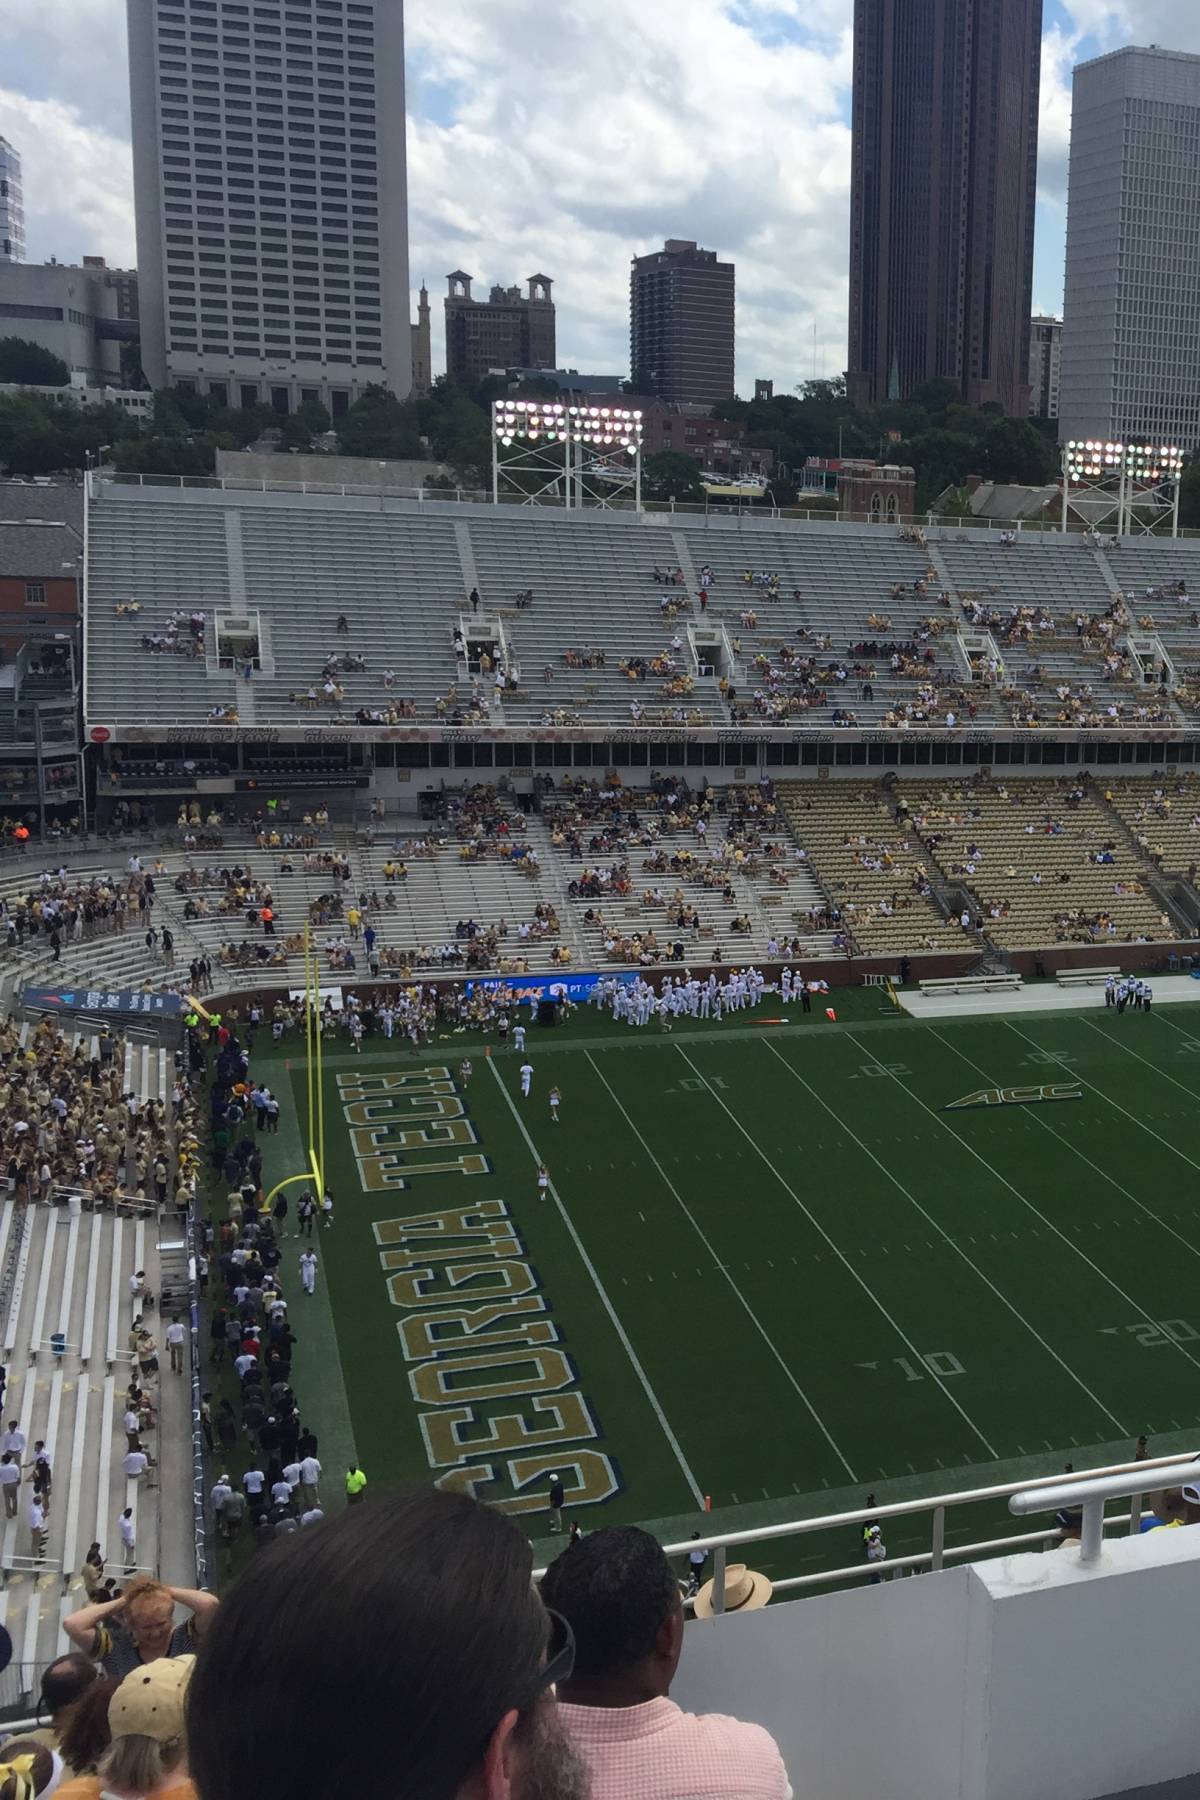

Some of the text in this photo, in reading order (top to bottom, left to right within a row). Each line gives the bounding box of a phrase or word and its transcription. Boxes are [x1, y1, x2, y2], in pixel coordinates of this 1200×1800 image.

[167, 733, 280, 743] HALL OF FAME
[305, 734, 352, 743] GUYON
[441, 734, 480, 743] SHAW
[603, 734, 697, 743] HALL OF FAME
[570, 984, 582, 993] PT
[1027, 1050, 1078, 1064] 30
[857, 1063, 914, 1080] 20
[679, 1075, 730, 1092] 10
[945, 1082, 1083, 1110] ACC
[336, 1067, 490, 1192] TECH
[371, 1199, 621, 1517] GEORGIA
[892, 1351, 967, 1382] 10
